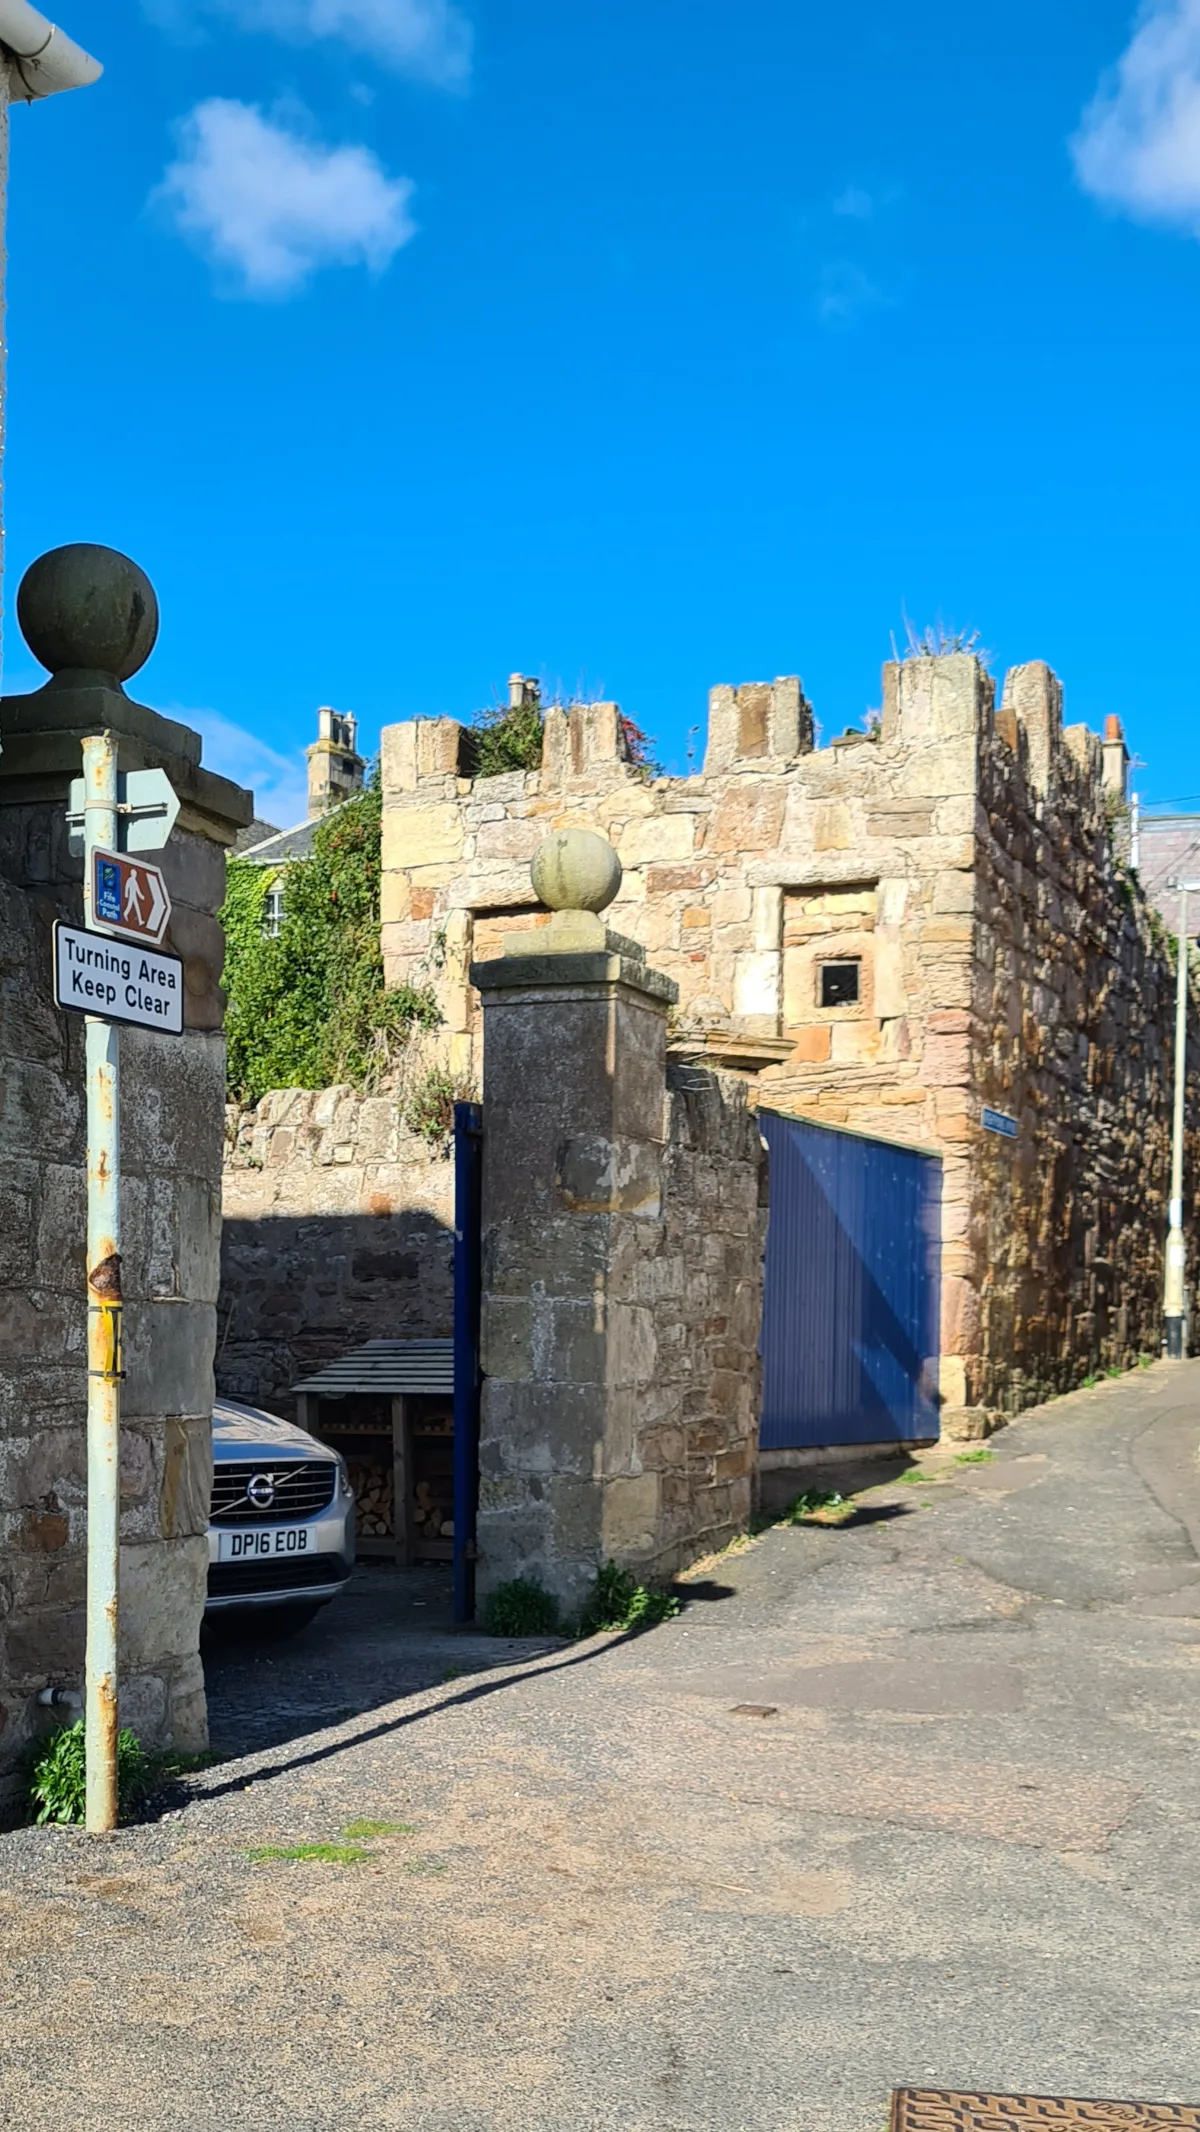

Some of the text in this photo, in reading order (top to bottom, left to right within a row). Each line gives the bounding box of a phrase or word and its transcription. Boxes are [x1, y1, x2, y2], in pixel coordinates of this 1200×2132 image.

[64, 937, 176, 989] Turning Area
[72, 969, 170, 1016] Keep Clear
[231, 1529, 307, 1556] DP16 EOB
